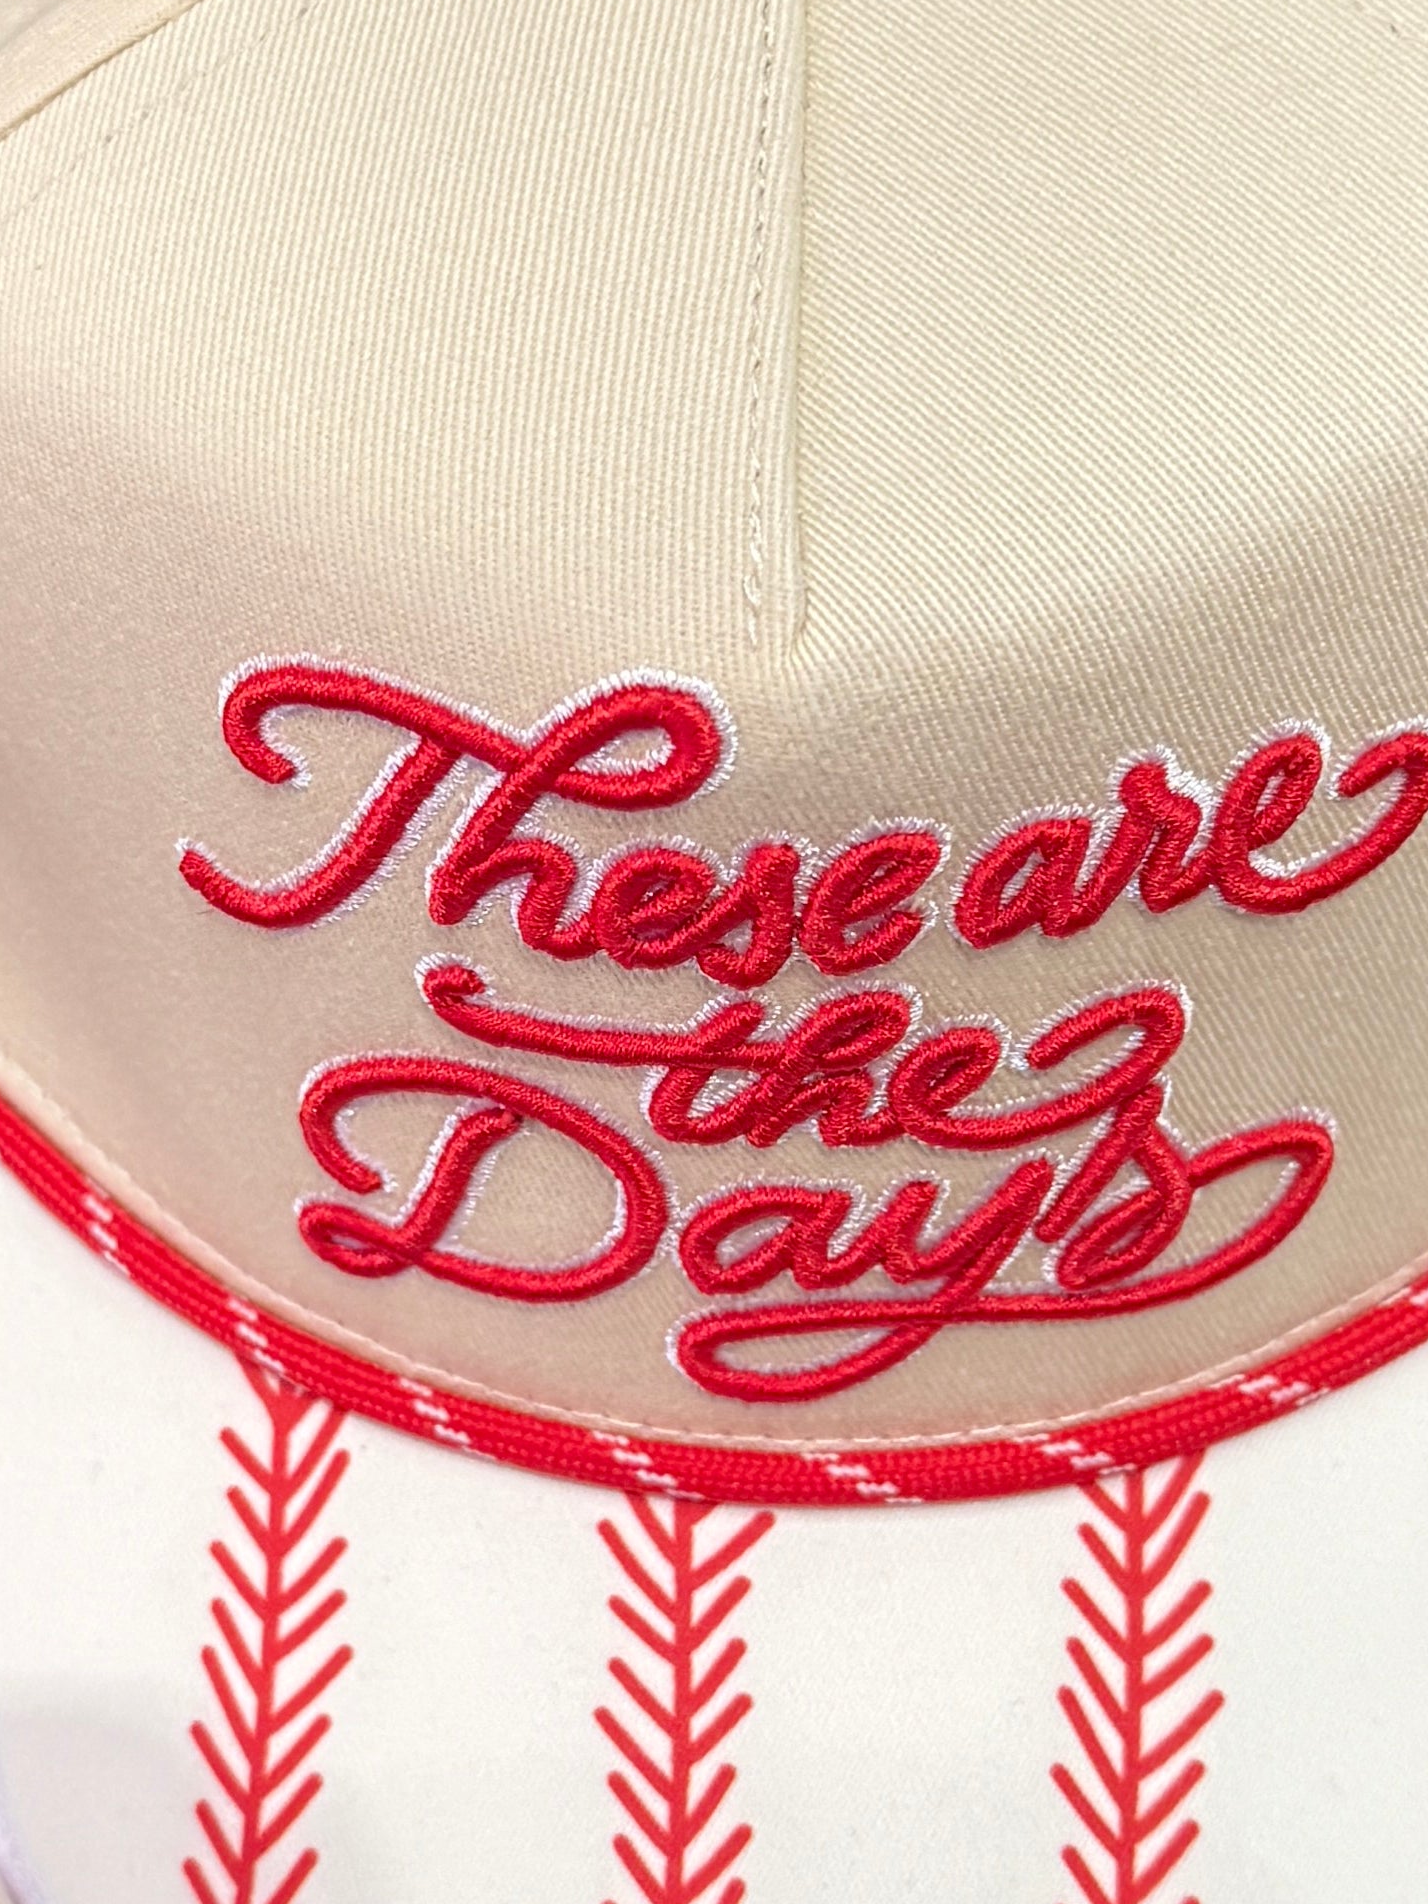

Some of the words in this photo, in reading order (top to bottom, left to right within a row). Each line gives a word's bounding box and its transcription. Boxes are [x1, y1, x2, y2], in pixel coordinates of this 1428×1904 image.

[177, 662, 943, 992] These
[421, 962, 1189, 1149] the
[298, 1055, 1336, 1405] Days
